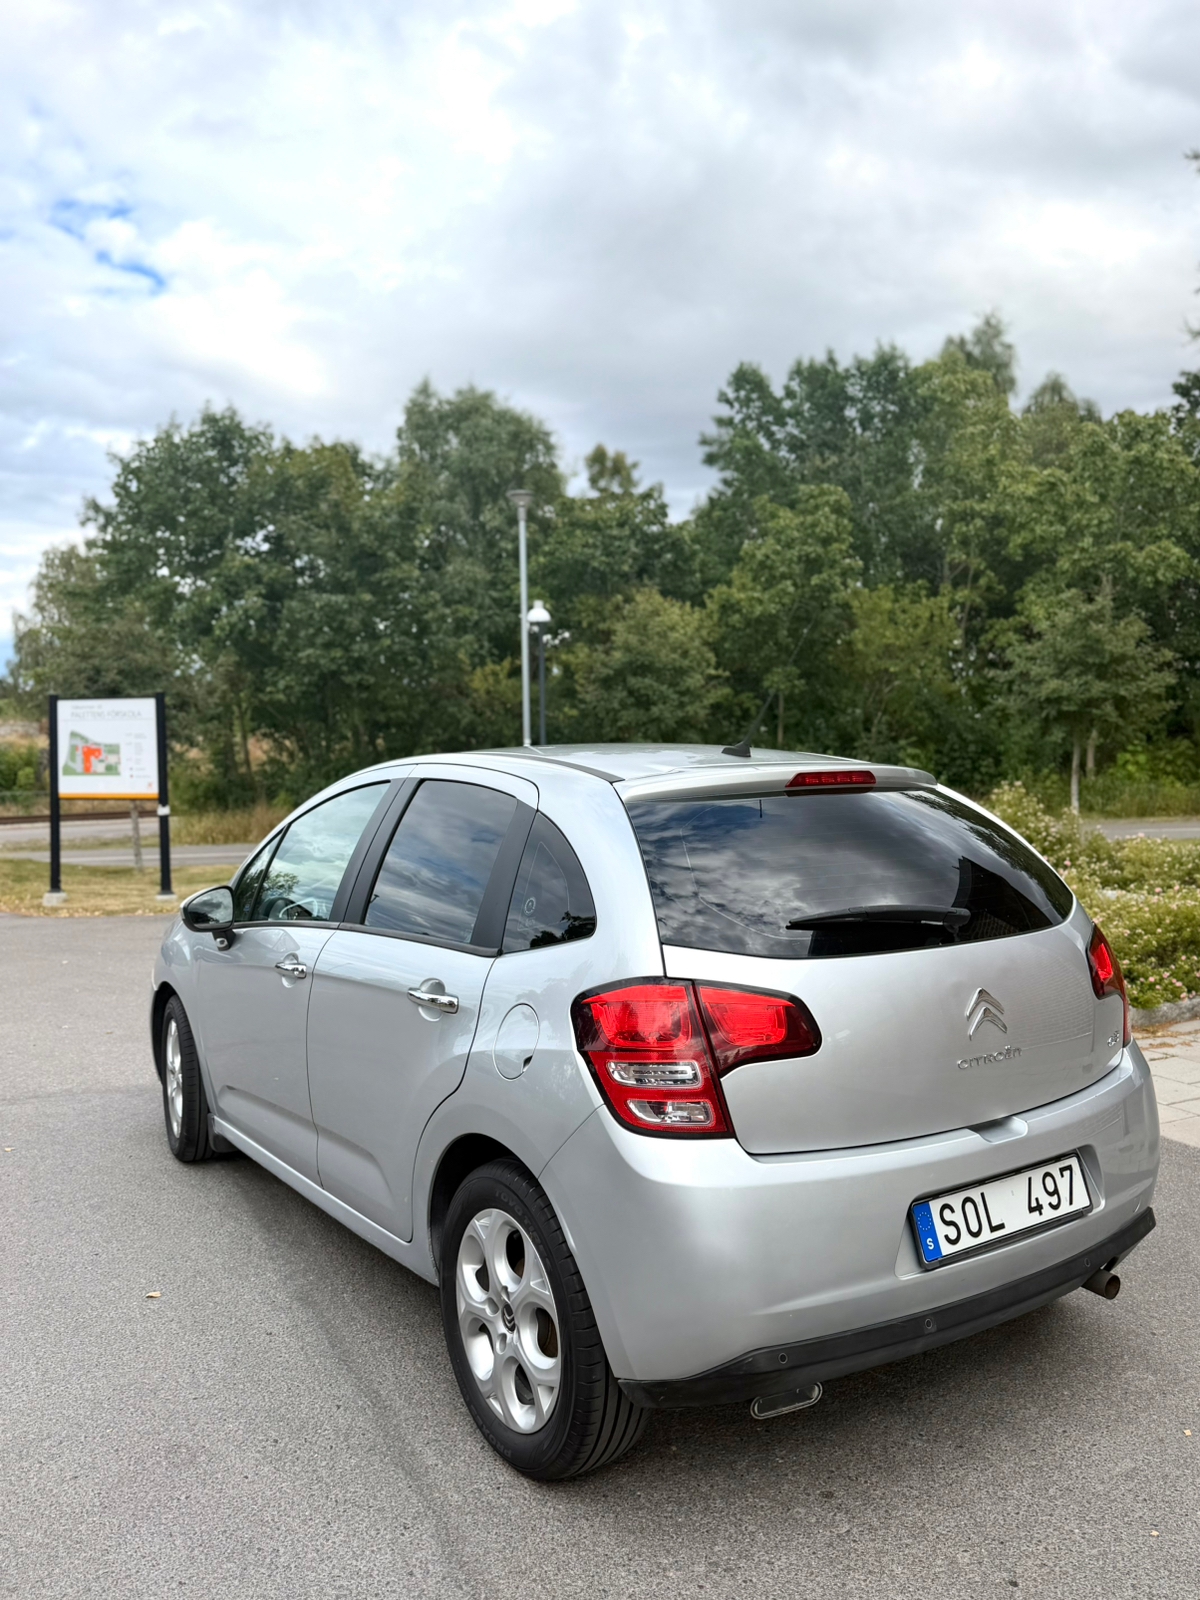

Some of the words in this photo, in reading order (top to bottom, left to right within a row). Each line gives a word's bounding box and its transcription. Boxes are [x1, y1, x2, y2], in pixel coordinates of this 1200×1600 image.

[939, 1191, 1006, 1246] SOL
[1026, 1164, 1074, 1216] 497
[926, 1237, 935, 1250] S
